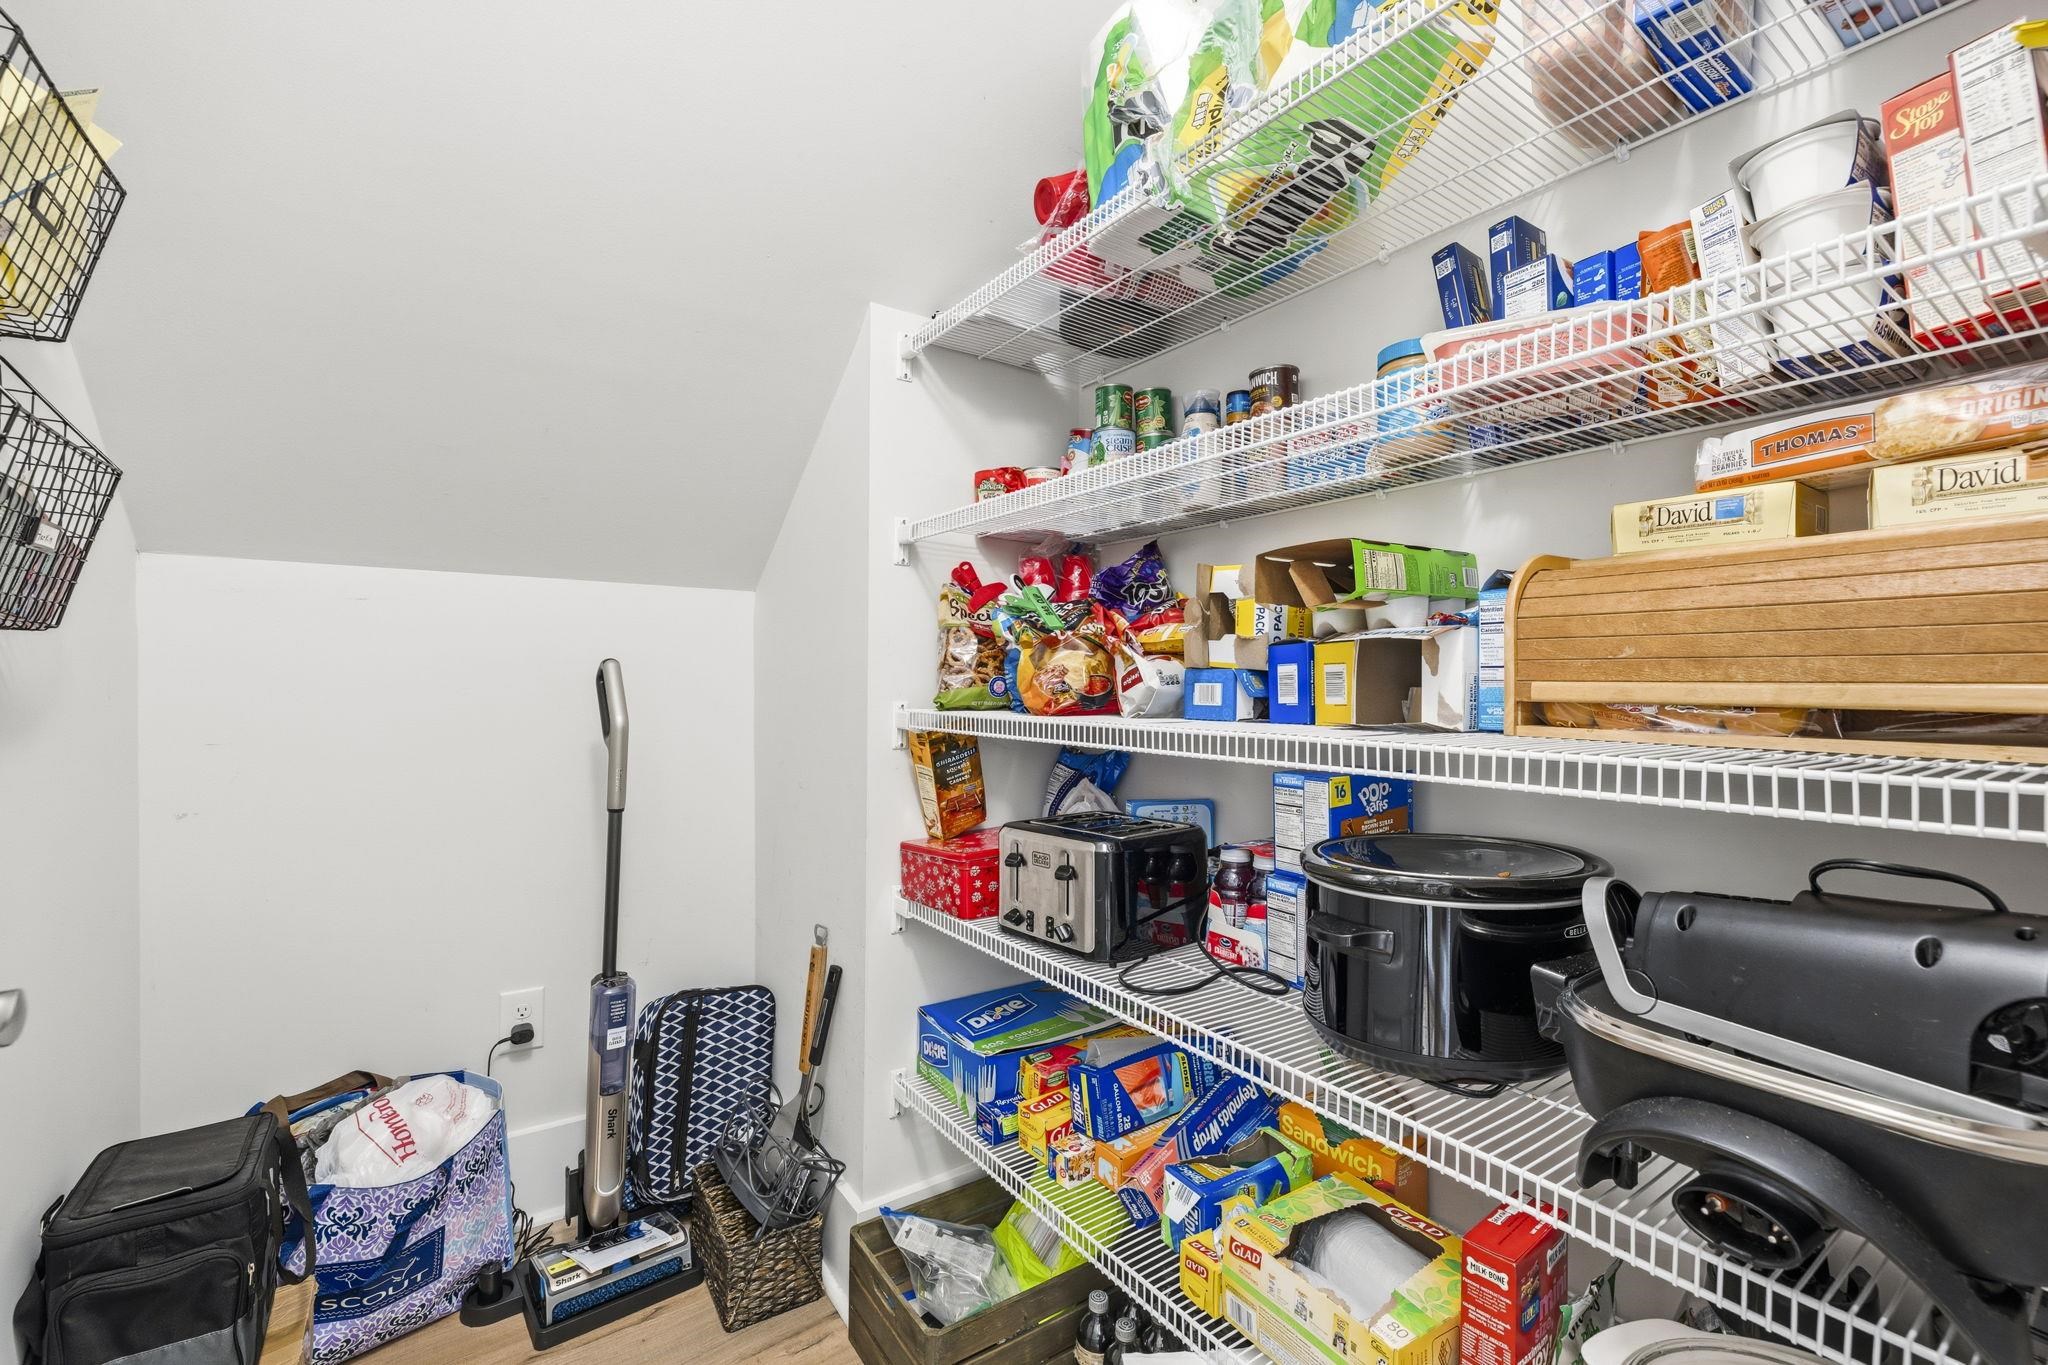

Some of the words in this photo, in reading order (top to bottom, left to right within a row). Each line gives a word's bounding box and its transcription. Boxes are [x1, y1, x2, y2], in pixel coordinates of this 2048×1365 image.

[1890, 90, 1952, 139] Stove
[1911, 109, 1944, 138] Top
[1105, 437, 1133, 446] steam
[1711, 459, 1748, 473] CRANNIES
[1937, 459, 2022, 493] David
[1656, 501, 1713, 527] David
[1256, 607, 1266, 635] PACK
[936, 747, 977, 768] GHIRARDELLI
[1334, 785, 1347, 799] 16
[1364, 799, 1389, 816] tarts
[1029, 1093, 1064, 1112] GLAD
[1112, 1082, 1122, 1108] GALLON
[1219, 1081, 1259, 1128] Reynolds
[607, 1109, 618, 1140] Shark
[1123, 1115, 1131, 1130] 28
[1192, 1118, 1223, 1152] Wrap
[1281, 1114, 1382, 1180] Sandwich
[1384, 1205, 1449, 1239] GLAD
[1231, 1239, 1262, 1267] GLAD
[555, 1272, 581, 1287] Shark
[1186, 1258, 1207, 1278] GLAD
[320, 1267, 429, 1311] SCOUT
[1540, 1273, 1568, 1320] mini
[1386, 1320, 1409, 1340] 80
